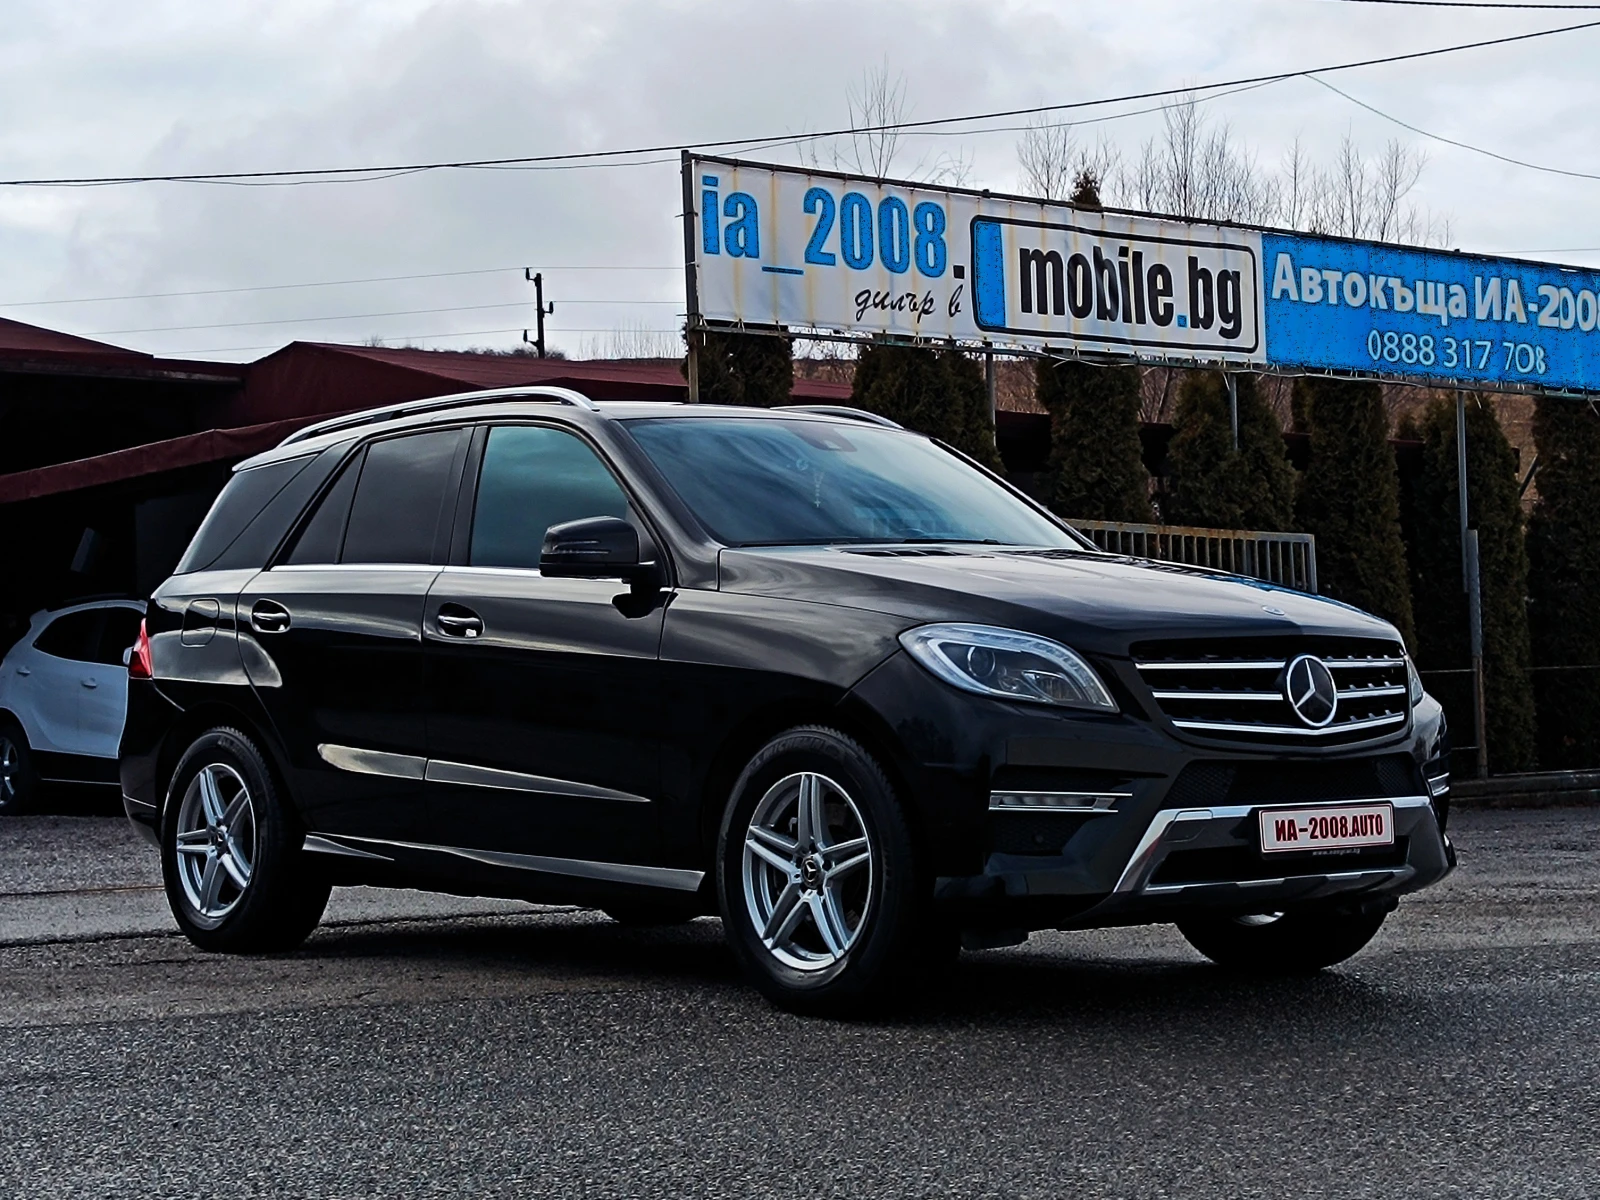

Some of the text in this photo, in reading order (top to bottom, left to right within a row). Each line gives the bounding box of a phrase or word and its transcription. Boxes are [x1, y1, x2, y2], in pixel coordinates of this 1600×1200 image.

[854, 287, 936, 323] дилър
[1019, 245, 1241, 340] mobile.bg
[1271, 252, 1600, 332] Автокъща ИА-200
[1367, 329, 1546, 375] 0888 317 708
